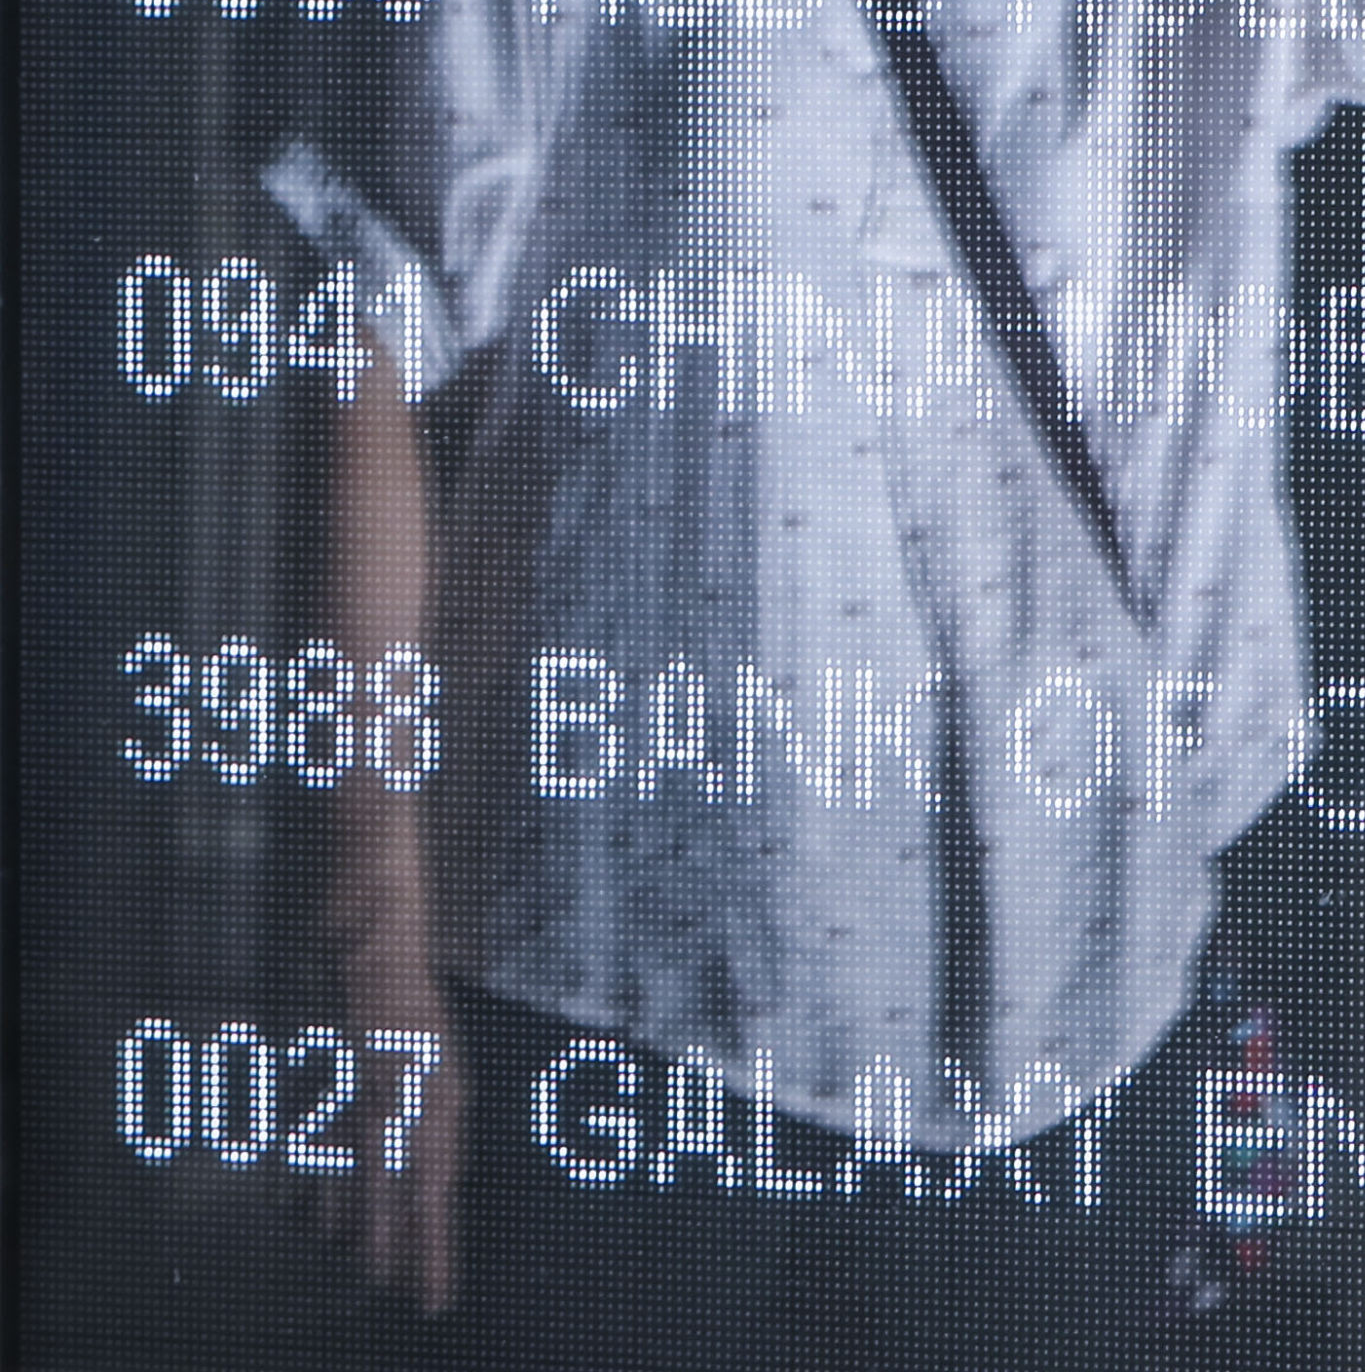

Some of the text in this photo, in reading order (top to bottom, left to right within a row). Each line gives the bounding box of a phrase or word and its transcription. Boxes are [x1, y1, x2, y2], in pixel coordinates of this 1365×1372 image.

[116, 252, 426, 404] 0941
[530, 264, 996, 420] CHINA
[116, 630, 442, 794] 3988
[530, 644, 948, 814] BANK
[1006, 664, 1218, 822] OF
[116, 1016, 442, 1172] 0027
[530, 1036, 1132, 1214] GALAXY
